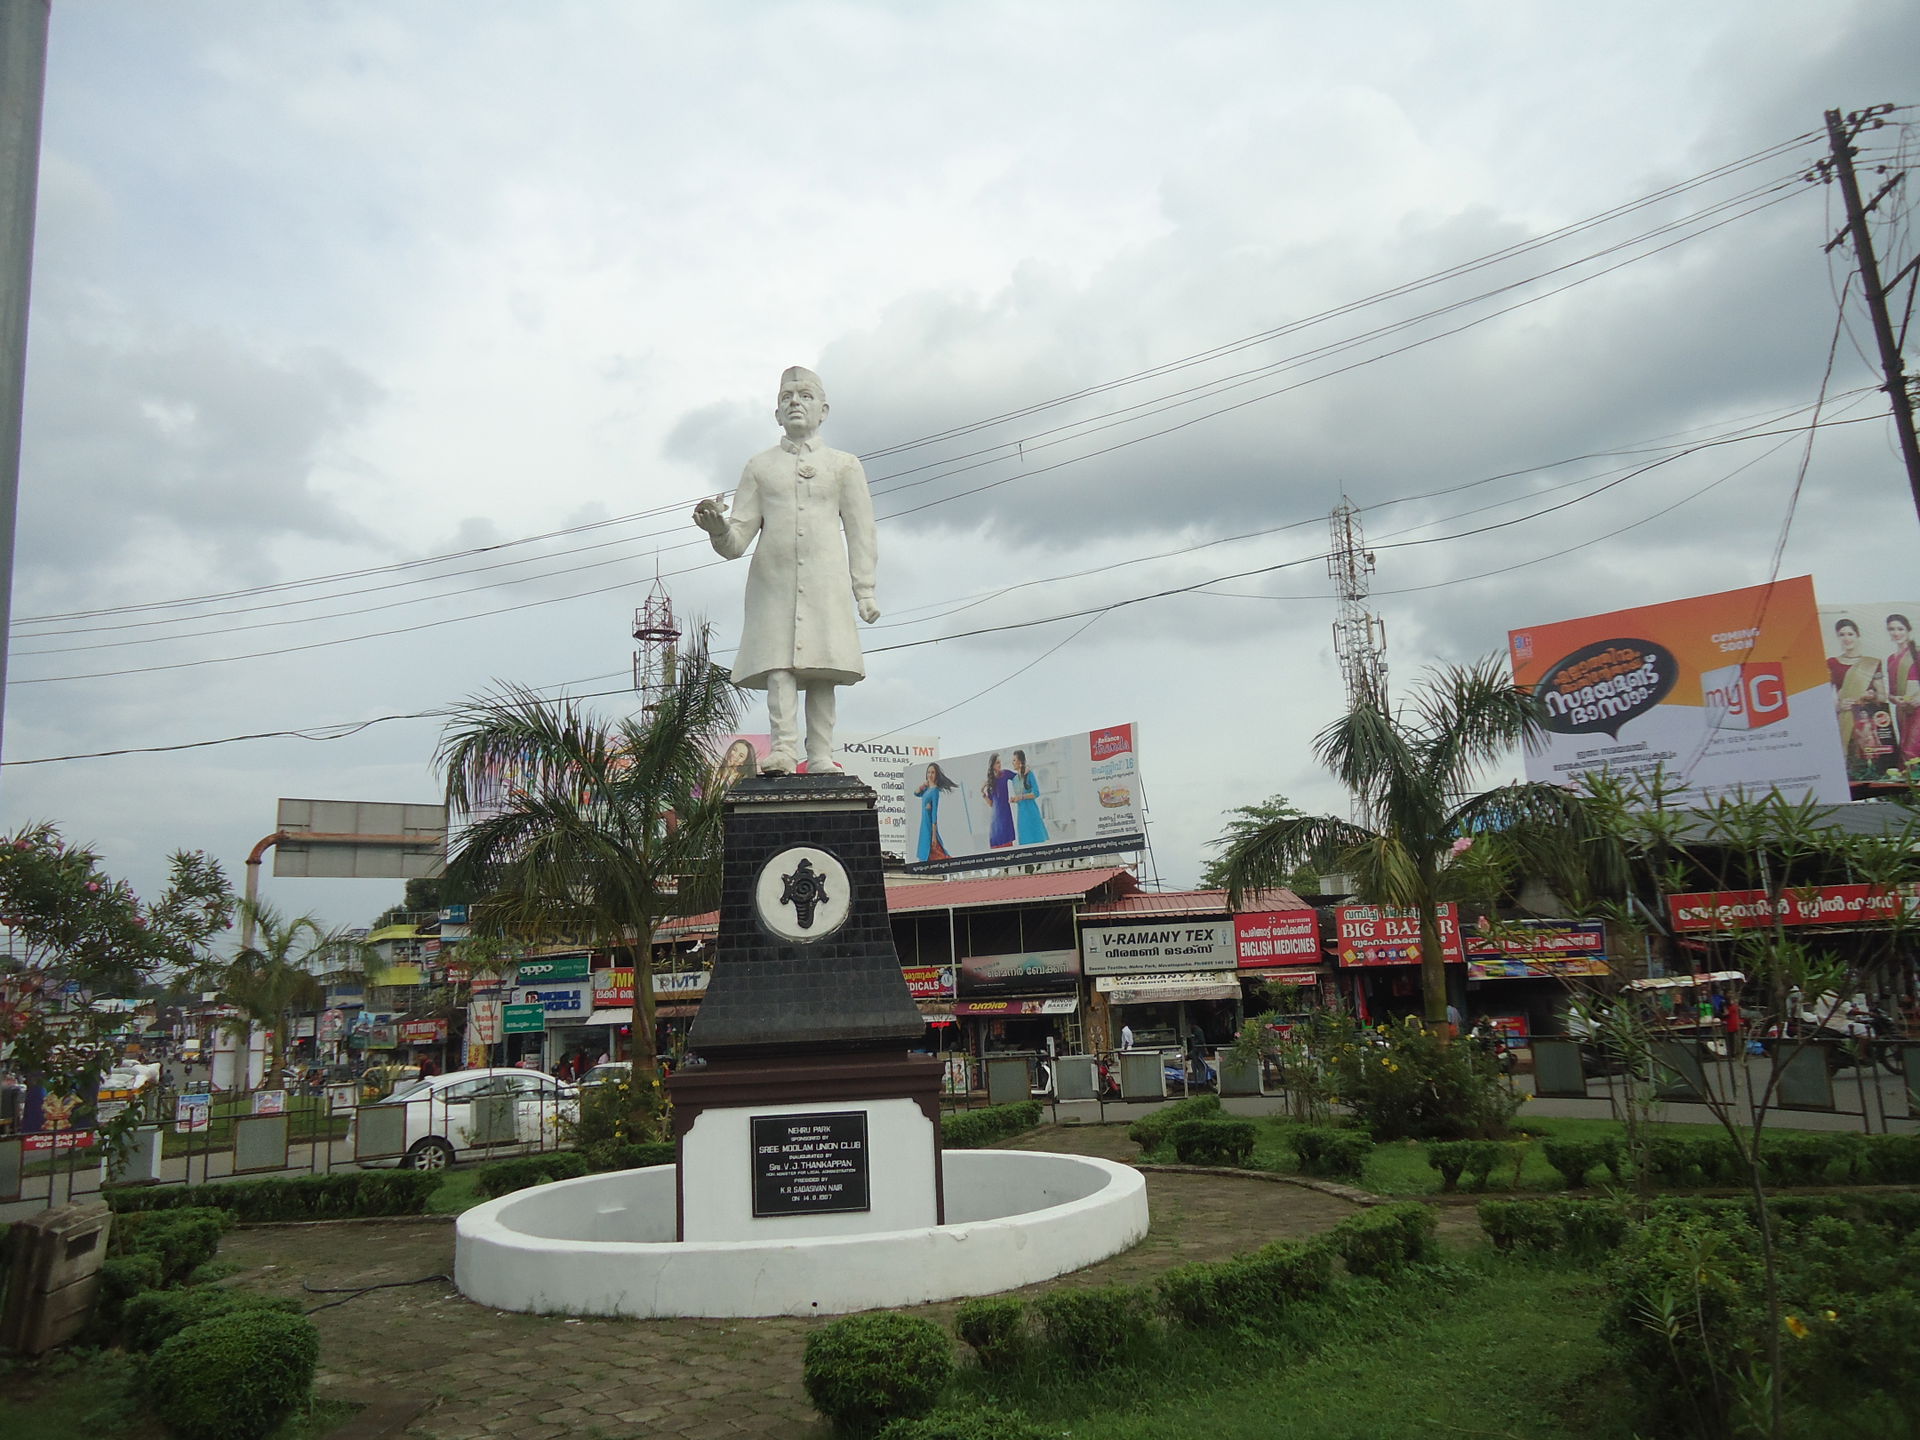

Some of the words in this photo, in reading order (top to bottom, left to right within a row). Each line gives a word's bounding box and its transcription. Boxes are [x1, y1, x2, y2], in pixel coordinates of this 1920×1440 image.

[1719, 639, 1754, 652] SOON
[1705, 674, 1784, 715] myG
[843, 743, 909, 756] KAIRALI
[912, 746, 935, 757] TMT
[1342, 921, 1376, 938] BIG
[1385, 919, 1454, 936] BAZR
[1102, 930, 1181, 946] V-RAMANY
[1185, 928, 1215, 942] TEX
[1352, 935, 1447, 947] ഗൃഹോപകരണൾ
[1240, 940, 1273, 957] ENGLISH
[1274, 937, 1316, 955] MEDICINES
[519, 964, 554, 977] oppo
[787, 1126, 811, 1135] NEHRU
[812, 1125, 831, 1134] PARK
[759, 1145, 780, 1154] SREE
[782, 1143, 814, 1152] MOOLAM
[816, 1142, 838, 1150] UNION
[840, 1141, 861, 1149] CLUB
[800, 1159, 852, 1170] THANKAPPAN
[793, 1184, 828, 1193] SADASIVAN
[828, 1184, 843, 1192] NAIR
